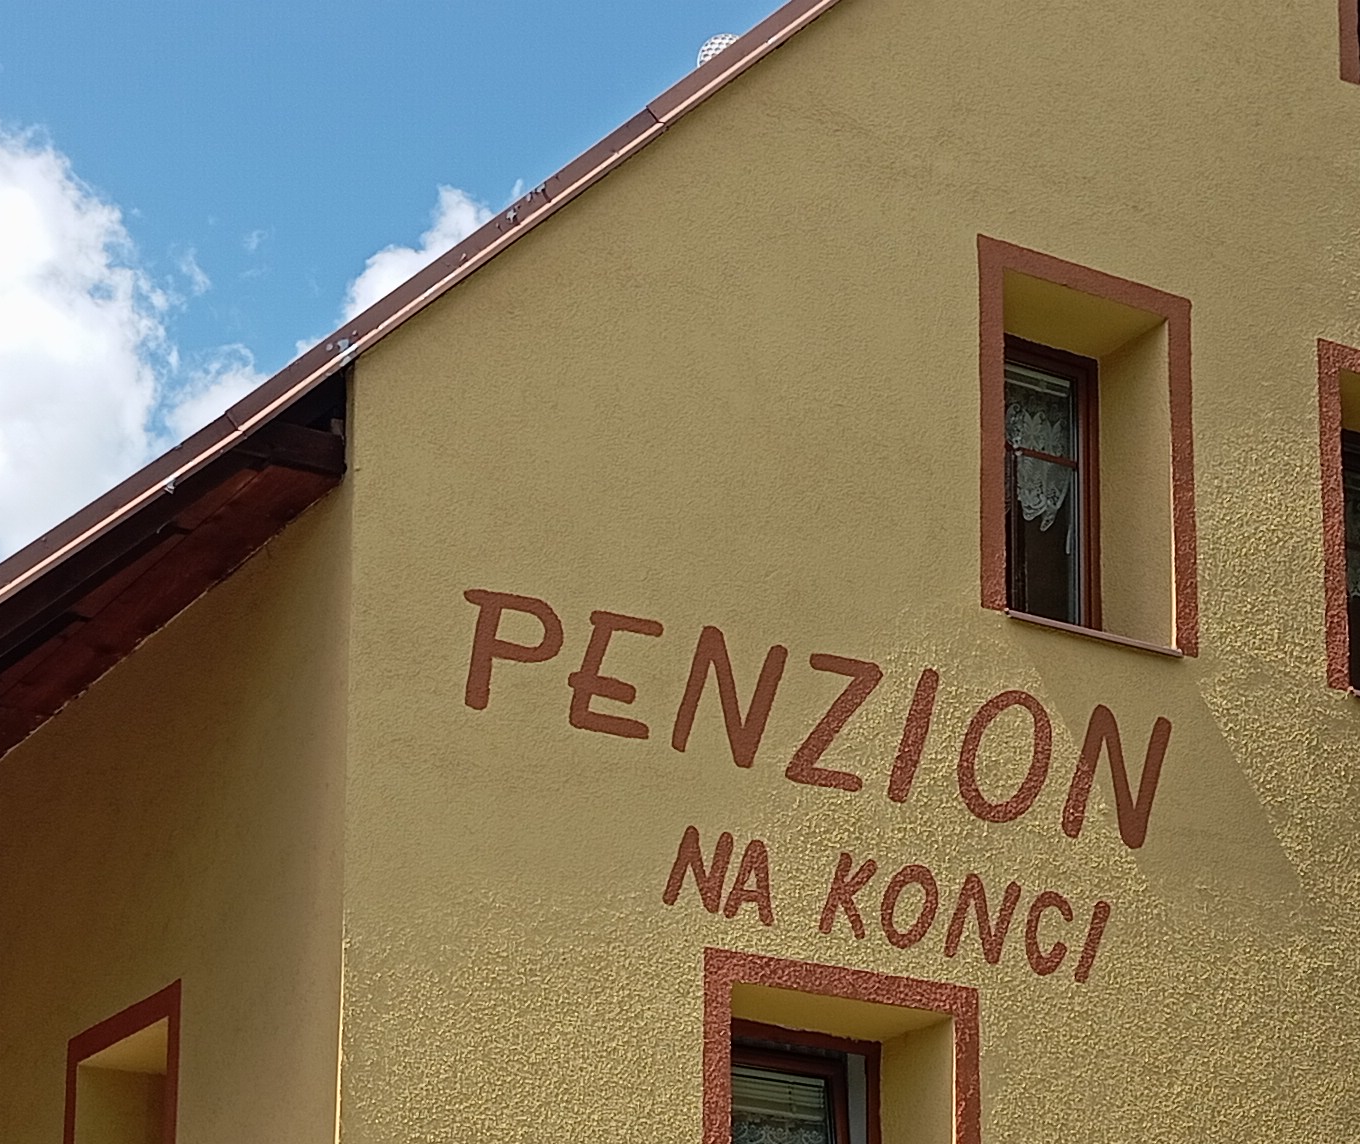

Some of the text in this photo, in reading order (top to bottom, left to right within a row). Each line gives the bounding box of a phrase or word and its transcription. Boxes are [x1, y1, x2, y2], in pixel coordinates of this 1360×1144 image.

[463, 588, 1173, 850] PENZION
[661, 825, 1111, 984] NA KONCI
